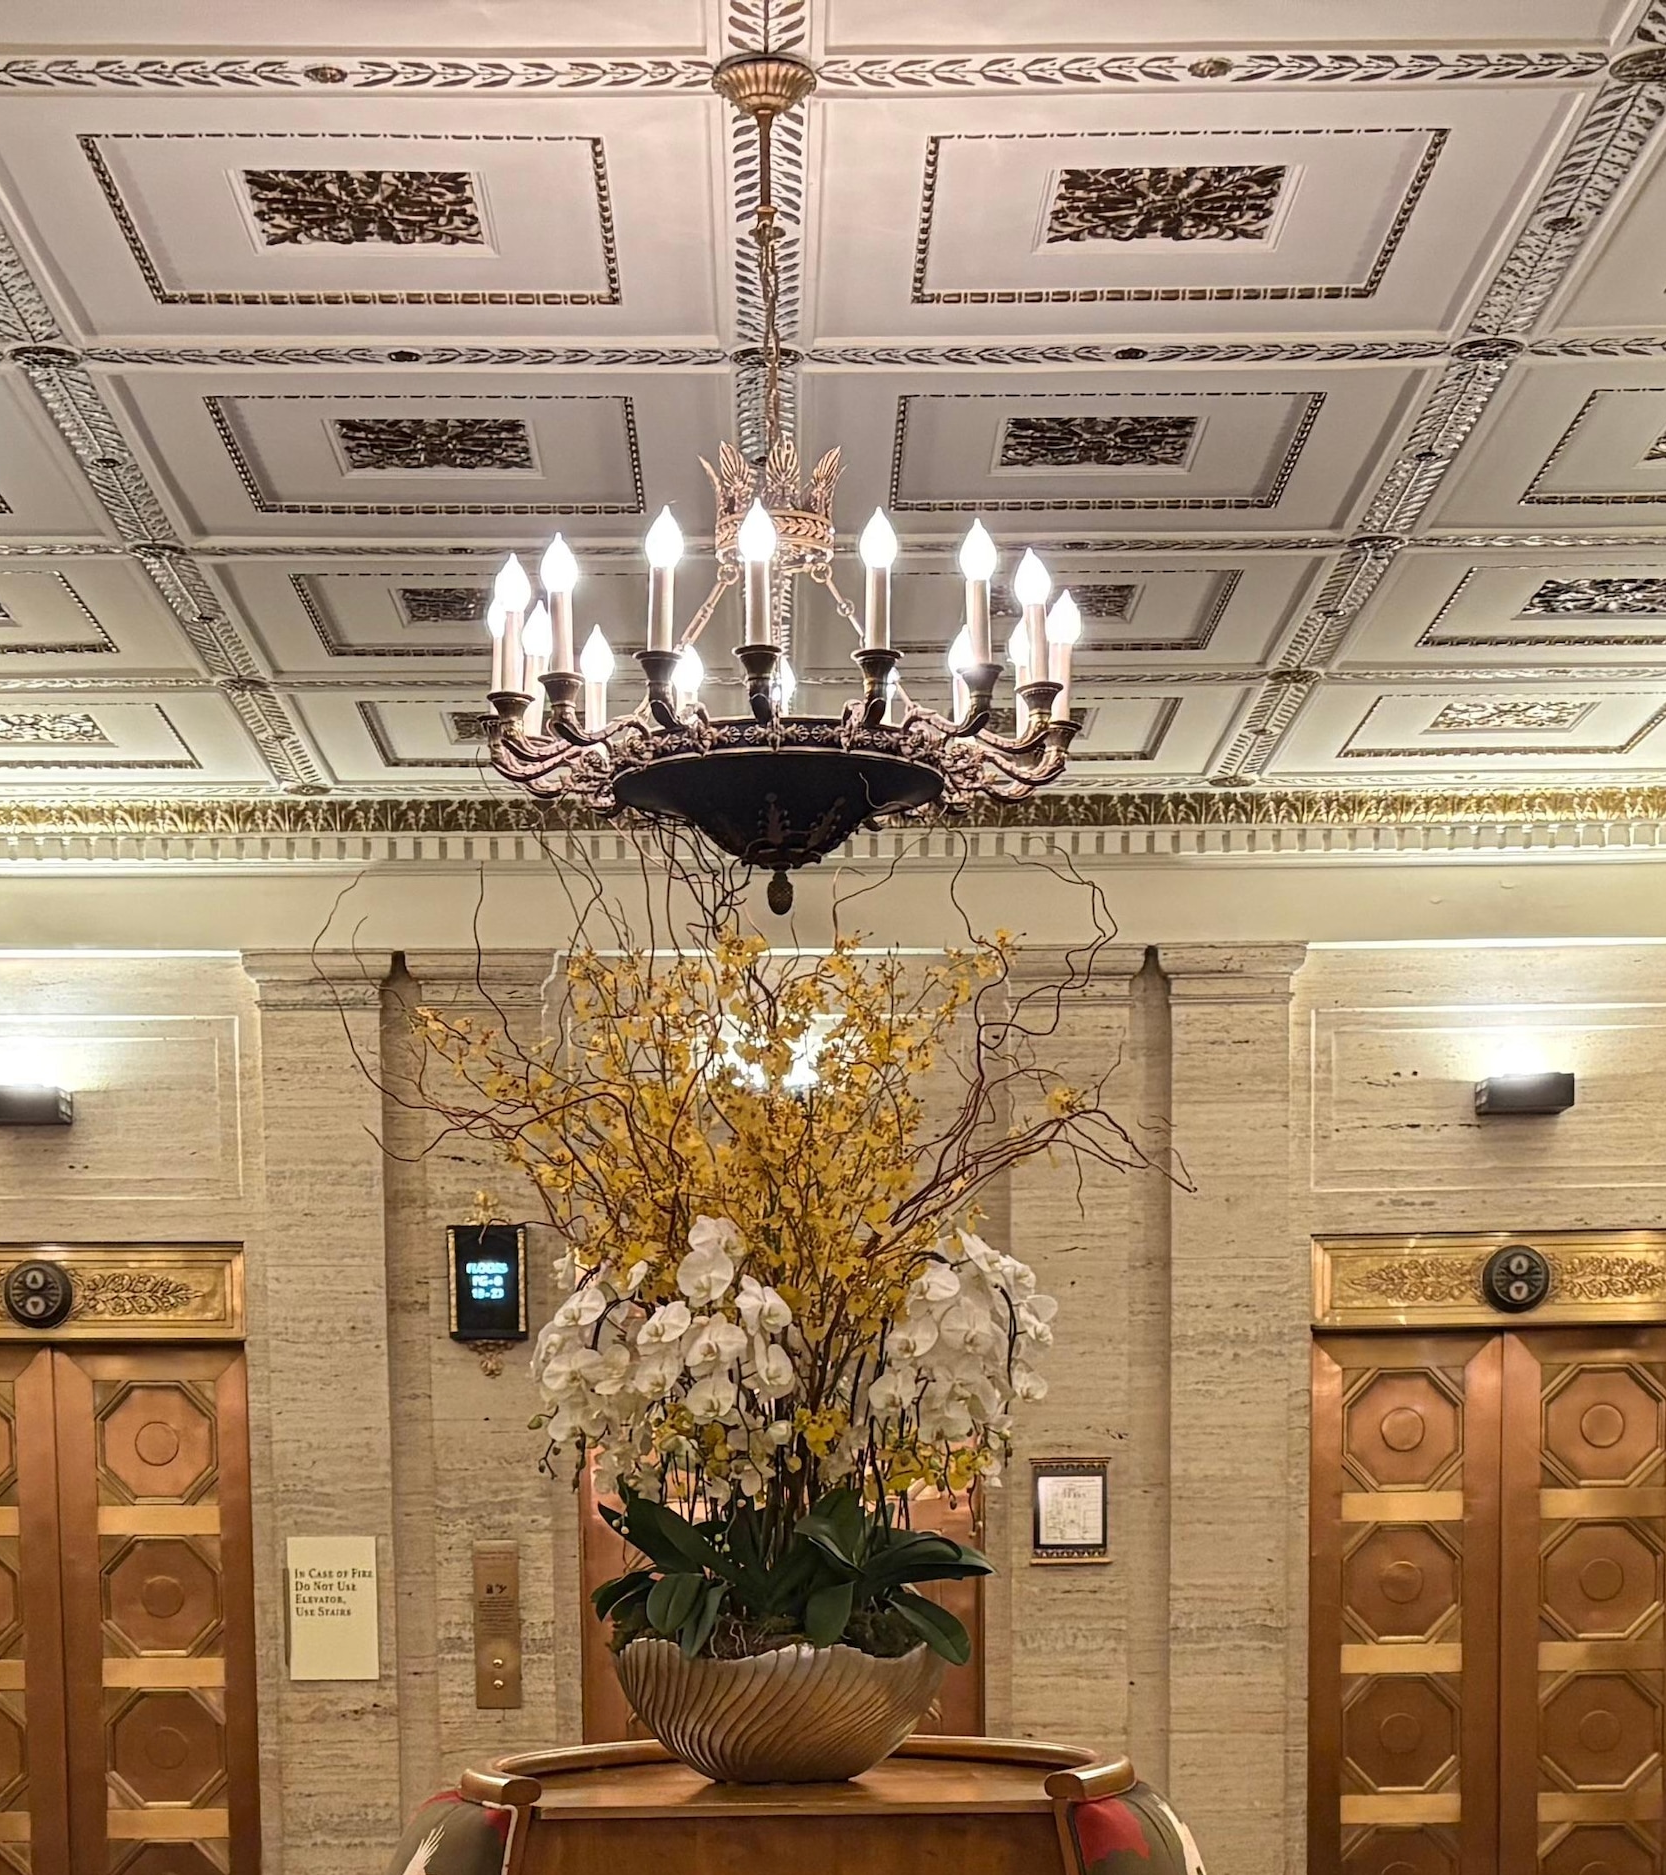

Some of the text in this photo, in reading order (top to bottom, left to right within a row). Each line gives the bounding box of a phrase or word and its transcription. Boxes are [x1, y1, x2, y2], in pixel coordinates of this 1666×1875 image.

[294, 1568, 373, 1579] IN CASE OF FIRE
[295, 1581, 357, 1591] DO NOT USE
[295, 1593, 347, 1605] ELEVATOR,
[296, 1606, 352, 1617] USE STAIRS
